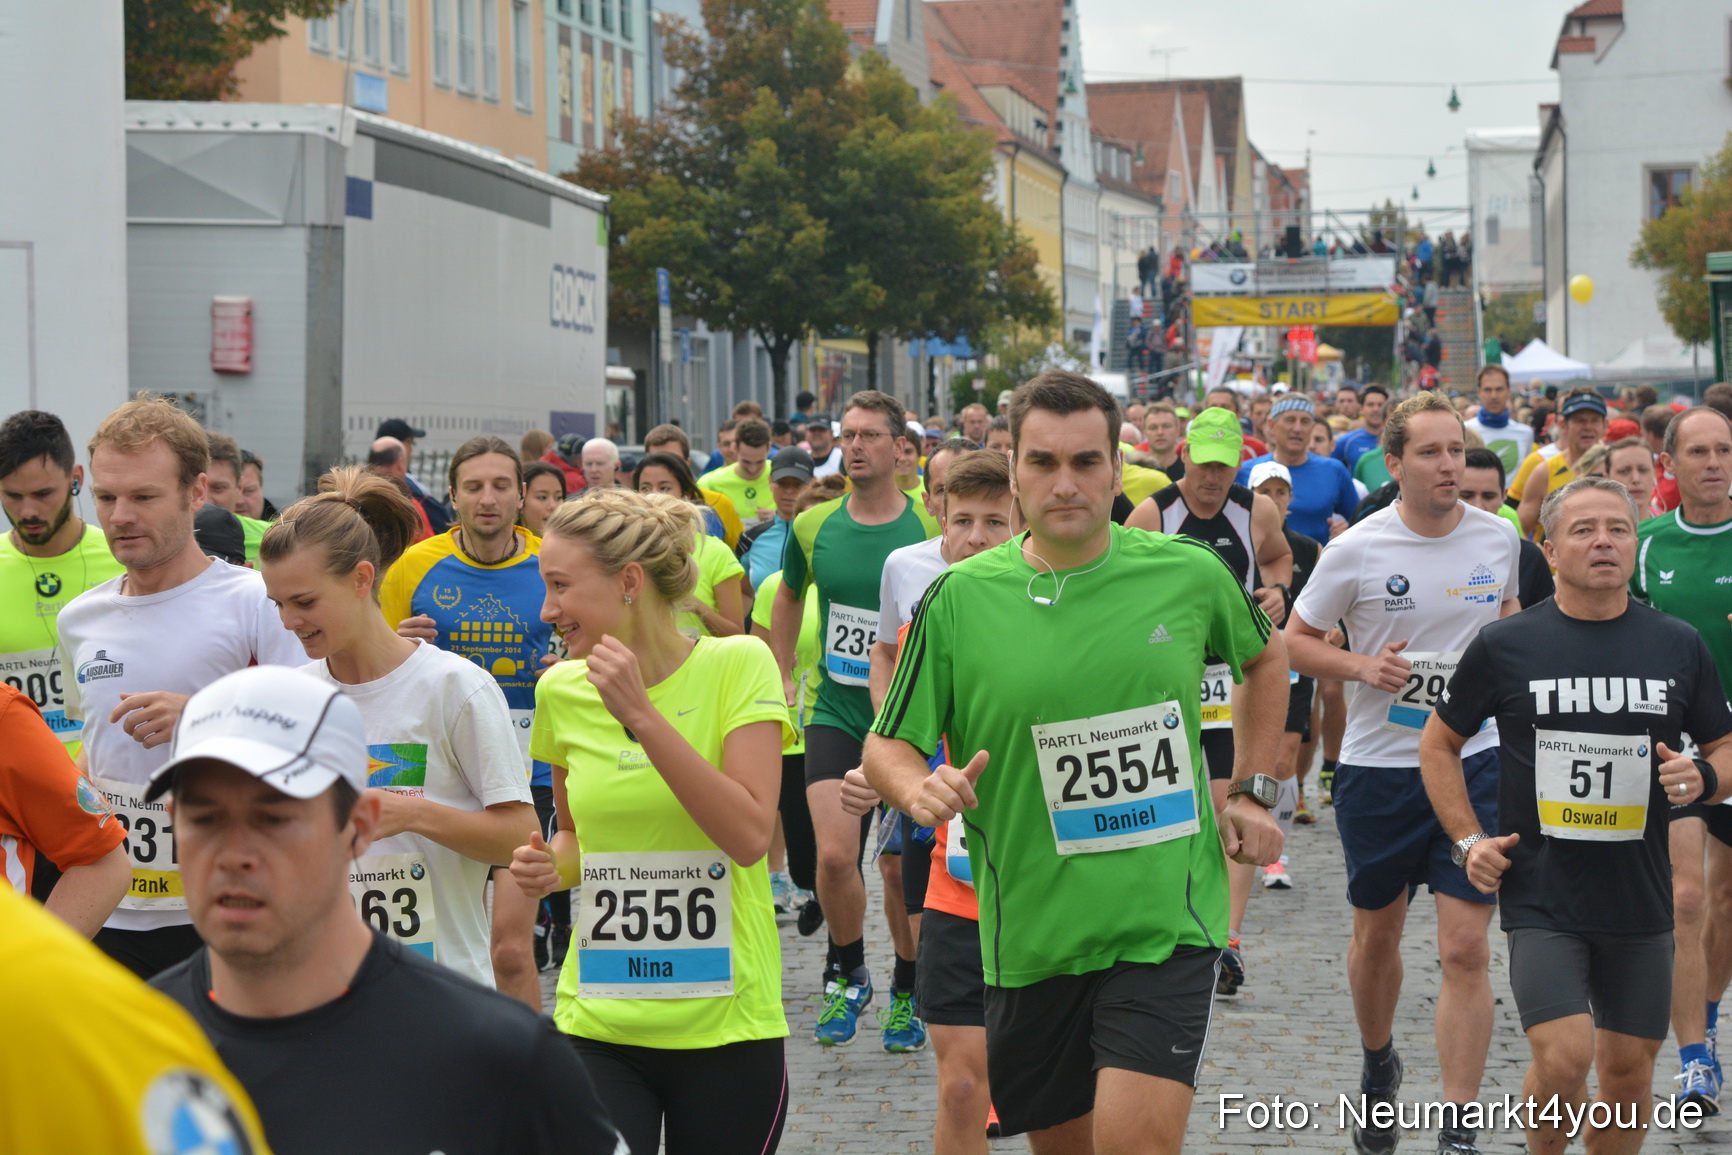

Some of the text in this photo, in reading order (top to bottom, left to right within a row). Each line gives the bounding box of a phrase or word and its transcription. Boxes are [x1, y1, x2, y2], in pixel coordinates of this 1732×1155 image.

[549, 264, 597, 334] BOCK
[1259, 300, 1329, 319] START
[1384, 597, 1416, 607] PARTL
[1385, 604, 1416, 612] Neumarkt
[830, 611, 855, 622] PARTL
[29, 658, 61, 668] Neum
[86, 662, 124, 677] AUSDAUER
[1411, 660, 1433, 670] RTL
[1529, 677, 1668, 715] THULE
[1634, 703, 1664, 712] SWEDEN
[1038, 719, 1159, 750] PARTL Neumarkt
[619, 751, 649, 762] Par
[1539, 740, 1633, 757] PARTL Neumarkt
[1056, 737, 1180, 803] 2554
[1569, 759, 1613, 799] 51
[99, 790, 126, 808] ARTL
[1053, 800, 1060, 810] C
[1094, 804, 1157, 833] Daniel
[1562, 808, 1618, 825] Oswald
[584, 866, 702, 881] PARTL Neumarkt
[131, 877, 169, 893] rank
[350, 887, 421, 938] 63
[591, 887, 717, 942] 2556
[581, 938, 587, 948] D
[628, 957, 674, 978] Nina
